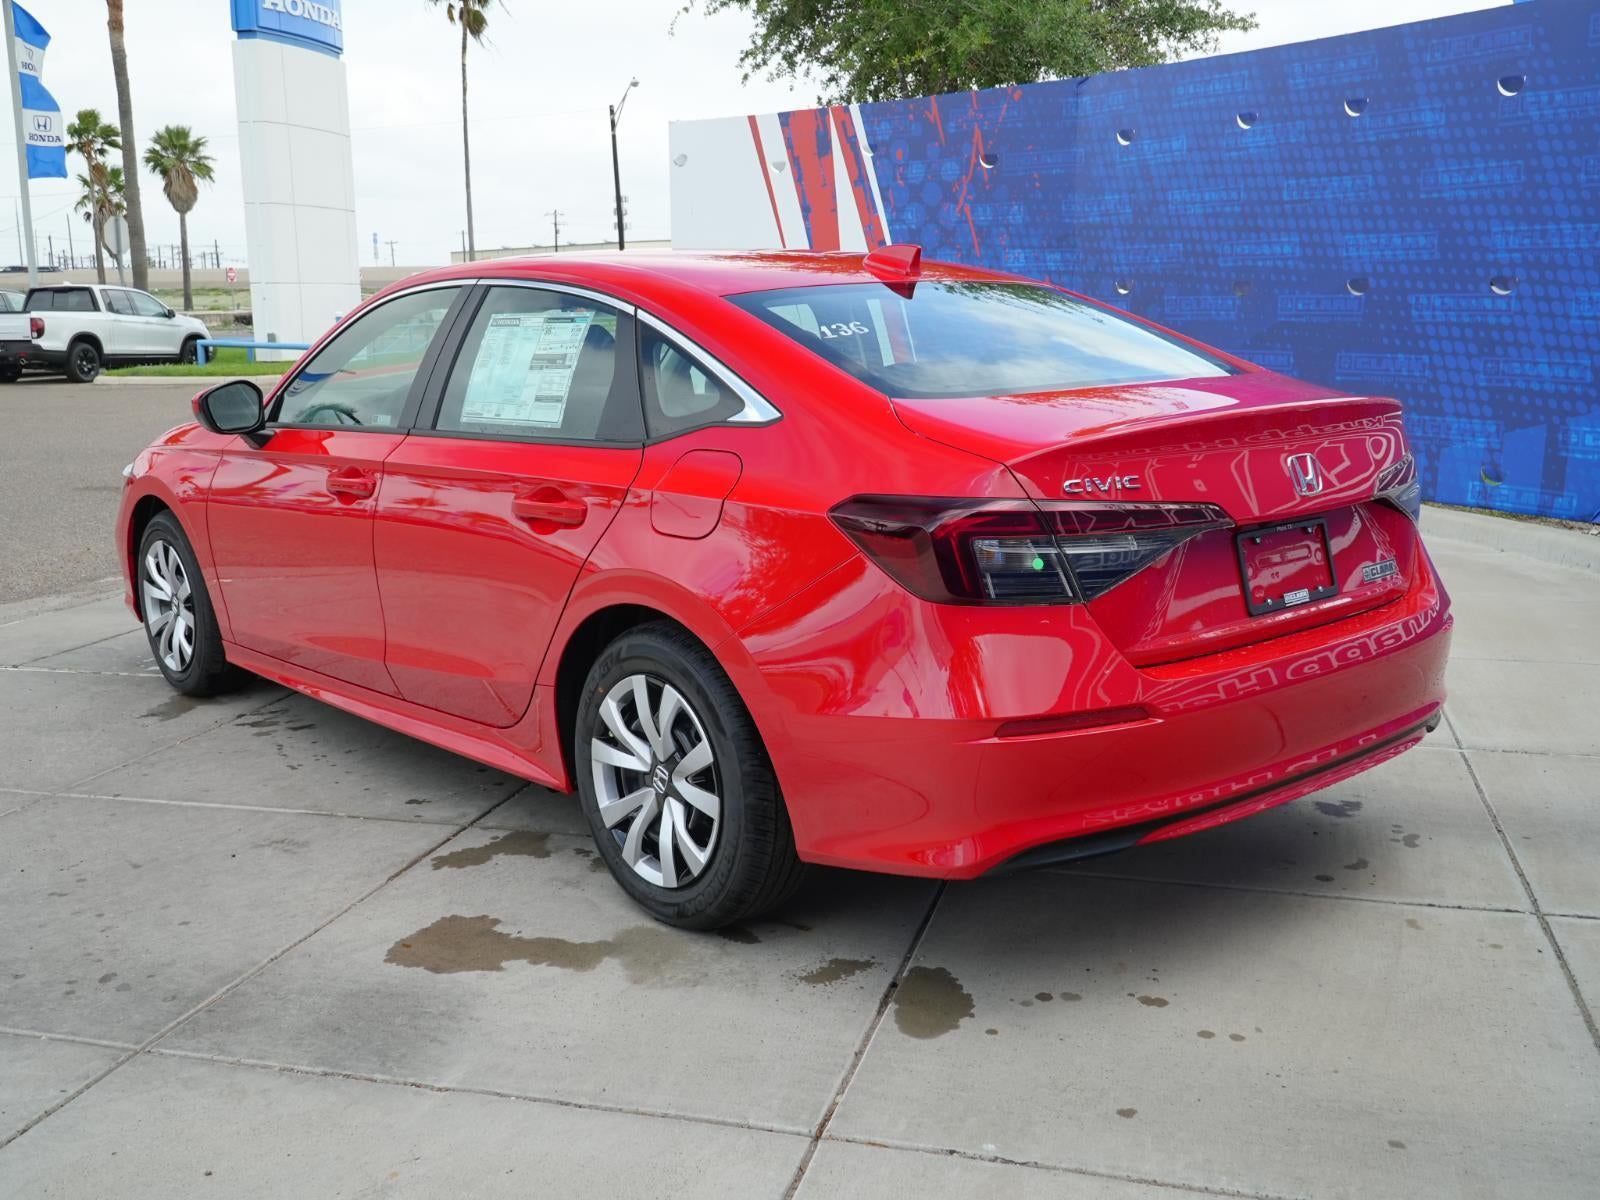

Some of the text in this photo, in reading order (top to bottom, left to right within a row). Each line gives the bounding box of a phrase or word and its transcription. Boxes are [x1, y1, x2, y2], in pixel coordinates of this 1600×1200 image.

[262, 0, 341, 31] HONDA
[28, 132, 62, 143] HONDA
[820, 321, 870, 339] 136
[1063, 475, 1141, 493] CIVIC
[1371, 561, 1394, 577] CLARK
